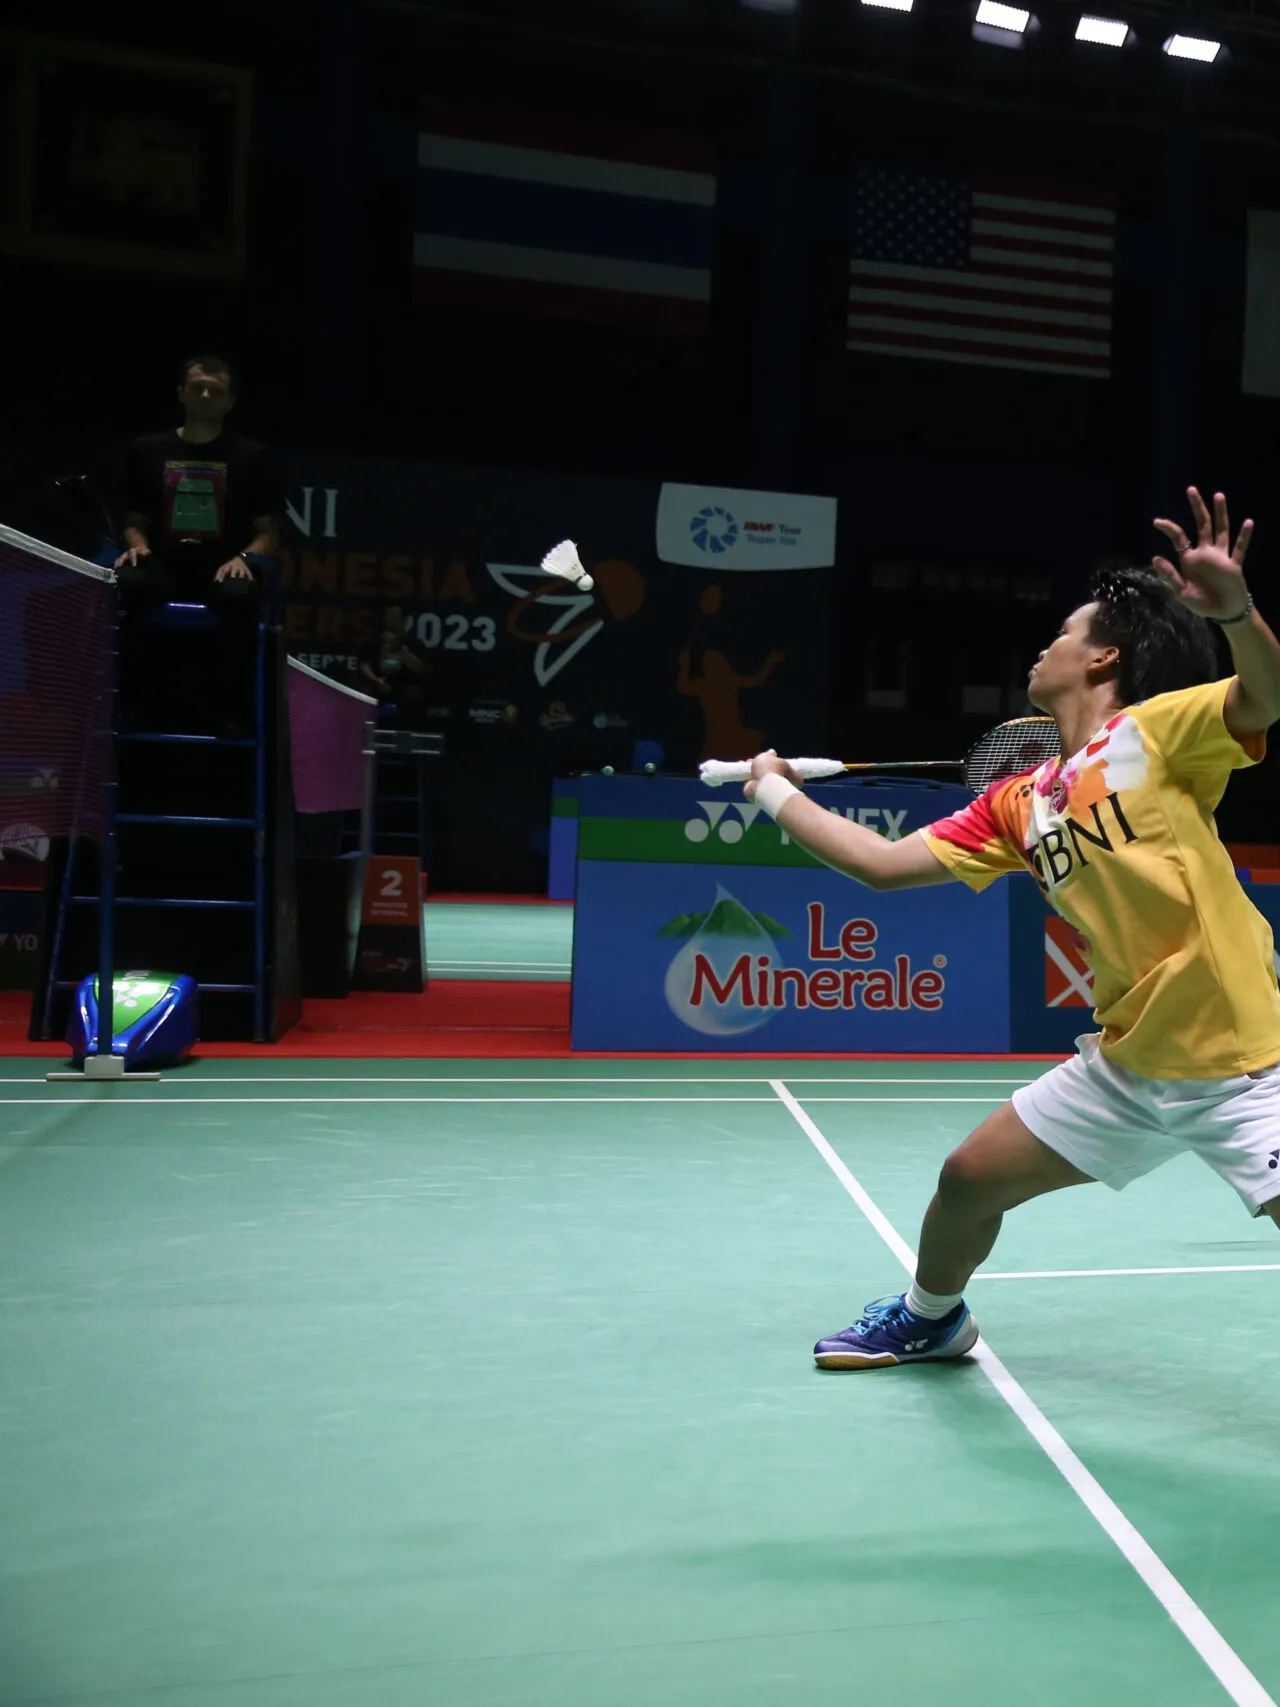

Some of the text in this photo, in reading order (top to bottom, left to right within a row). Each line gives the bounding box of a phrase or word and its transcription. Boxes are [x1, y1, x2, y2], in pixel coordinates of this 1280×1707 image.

[1040, 792, 1139, 884] BNI
[380, 869, 403, 896] 2
[807, 901, 878, 961] Le
[689, 954, 946, 1011] Minerale
